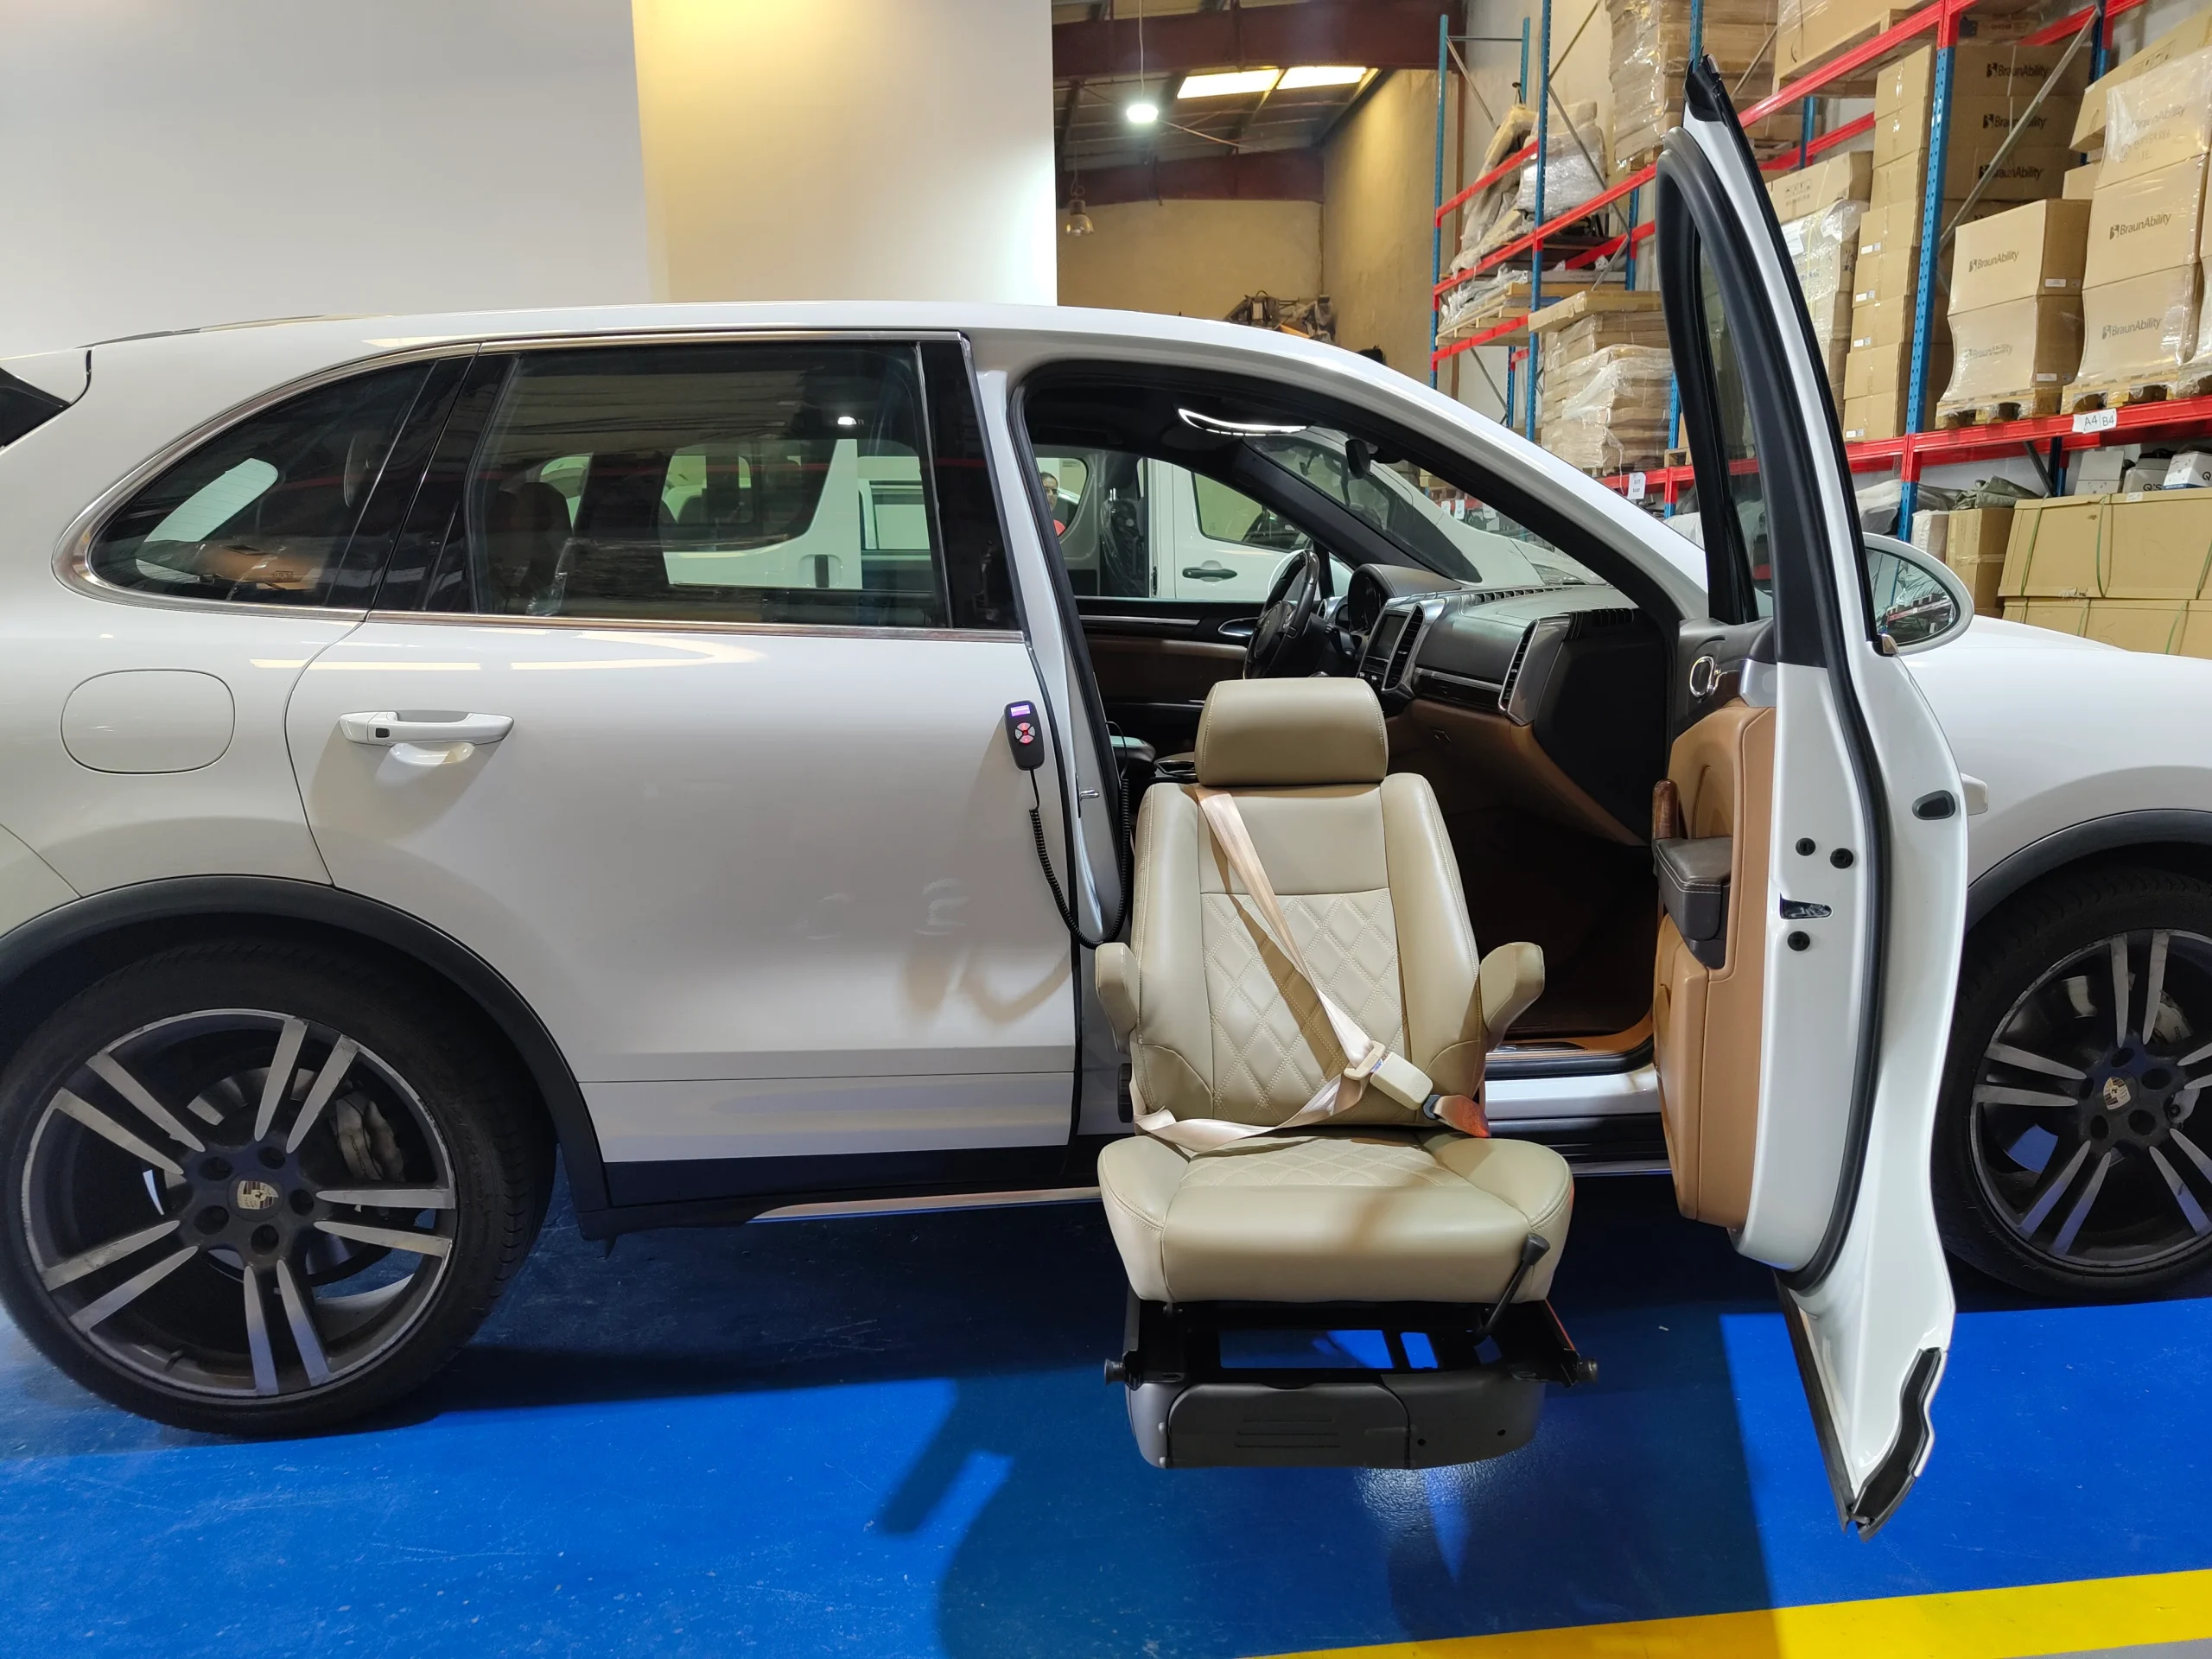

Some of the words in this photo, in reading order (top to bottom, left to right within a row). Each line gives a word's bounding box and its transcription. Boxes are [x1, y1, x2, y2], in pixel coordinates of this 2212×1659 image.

[2120, 213, 2172, 235] BraunAbility
[1977, 250, 2019, 270] BraunAbility
[2112, 317, 2162, 337] BraunAbility
[2085, 415, 2098, 427] A4
[2101, 415, 2114, 426] B4
